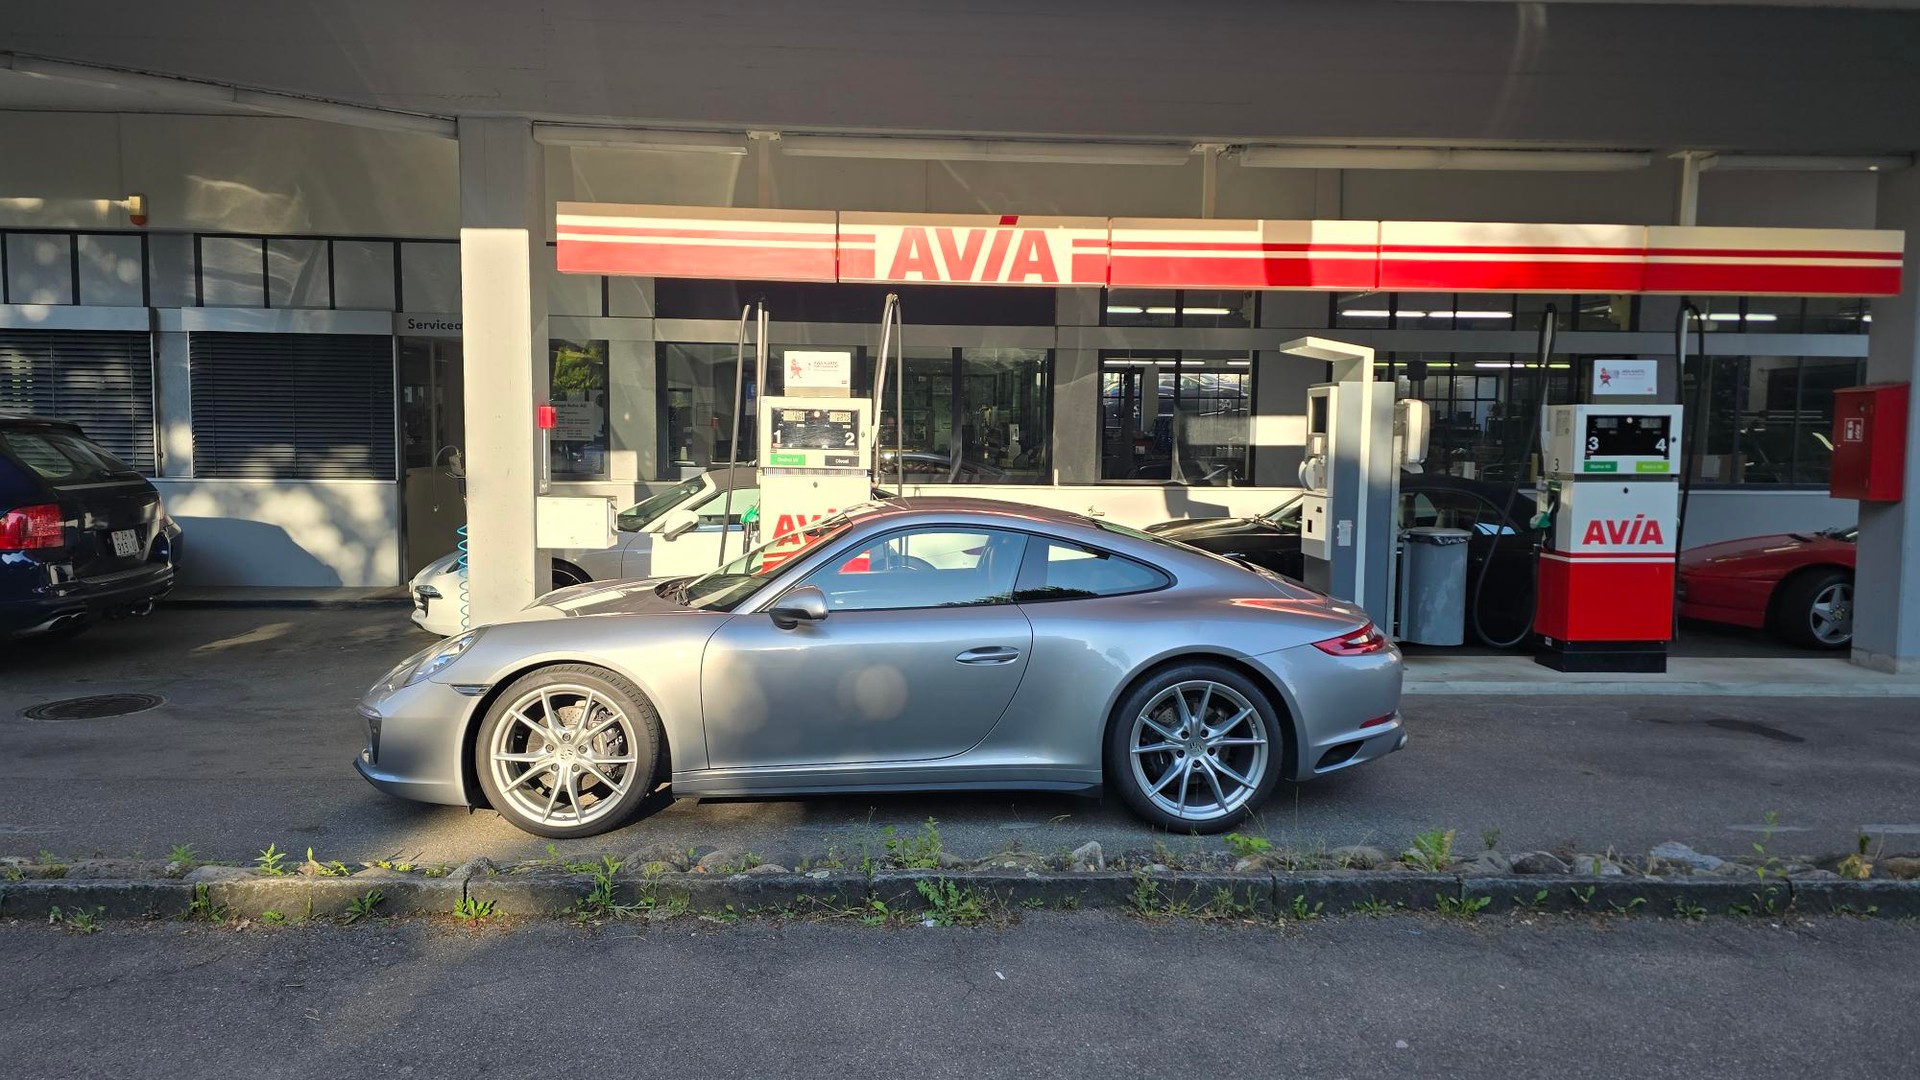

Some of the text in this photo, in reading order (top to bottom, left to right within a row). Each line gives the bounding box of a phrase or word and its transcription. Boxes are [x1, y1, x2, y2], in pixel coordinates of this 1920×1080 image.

[773, 429, 782, 444] 1
[844, 432, 856, 446] 2
[1588, 436, 1599, 450] 3
[1655, 438, 1667, 452] 4
